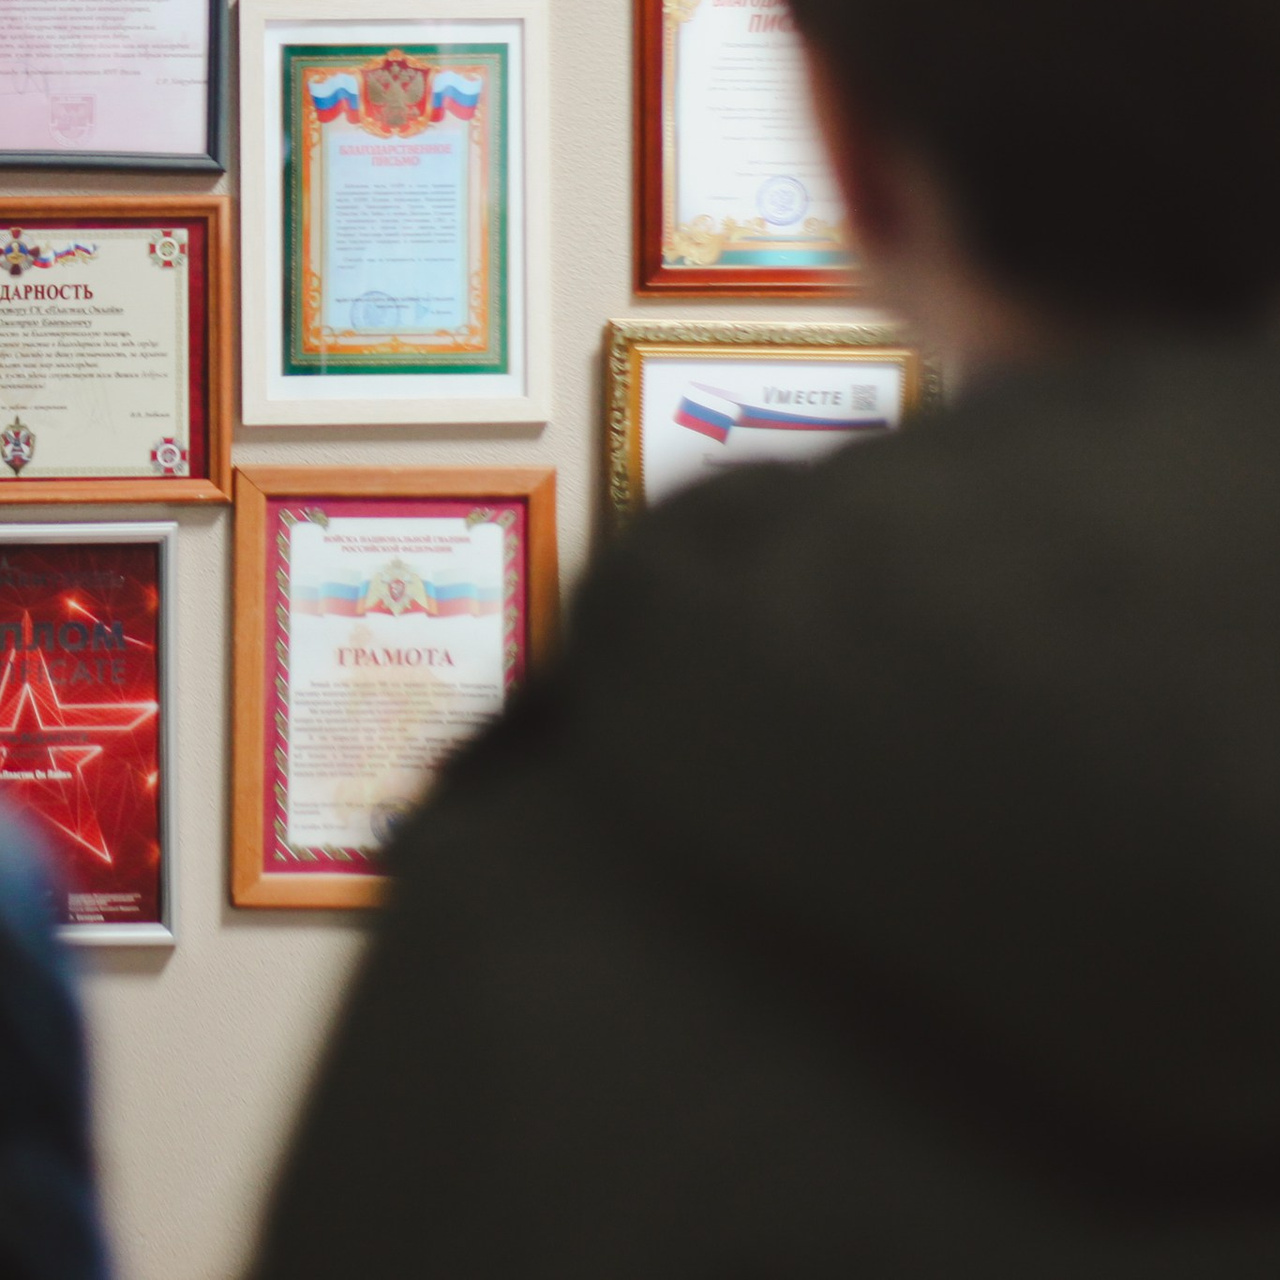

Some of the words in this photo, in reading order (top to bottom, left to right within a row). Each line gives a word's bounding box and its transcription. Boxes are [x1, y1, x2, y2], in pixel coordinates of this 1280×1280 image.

[338, 144, 453, 156] БЛАГОДАРСТВЕННОЕ
[372, 156, 421, 167] ПИСЬМО
[337, 646, 454, 667] ГРАМОТА
